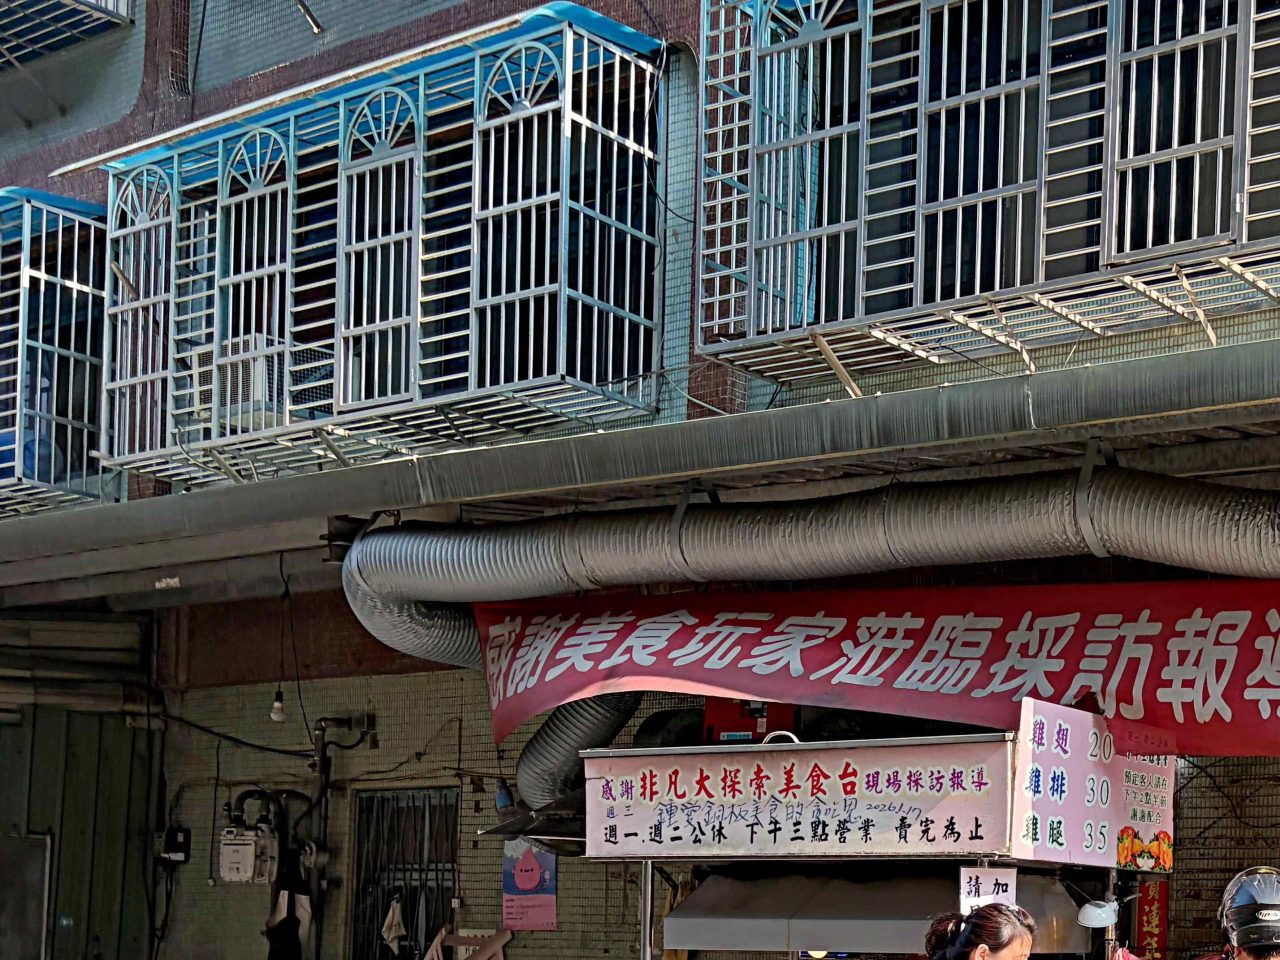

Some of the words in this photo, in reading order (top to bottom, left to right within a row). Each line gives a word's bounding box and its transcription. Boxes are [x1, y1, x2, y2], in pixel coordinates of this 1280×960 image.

[1029, 719, 1070, 755] 雞翅
[1089, 731, 1112, 761] 20
[1025, 767, 1067, 802] 雞排
[1086, 777, 1109, 806] 30
[746, 818, 876, 844] 下午三點營業
[895, 815, 984, 844] 賣完為止
[1022, 815, 1065, 847] 雞腿
[1084, 823, 1107, 850] 35
